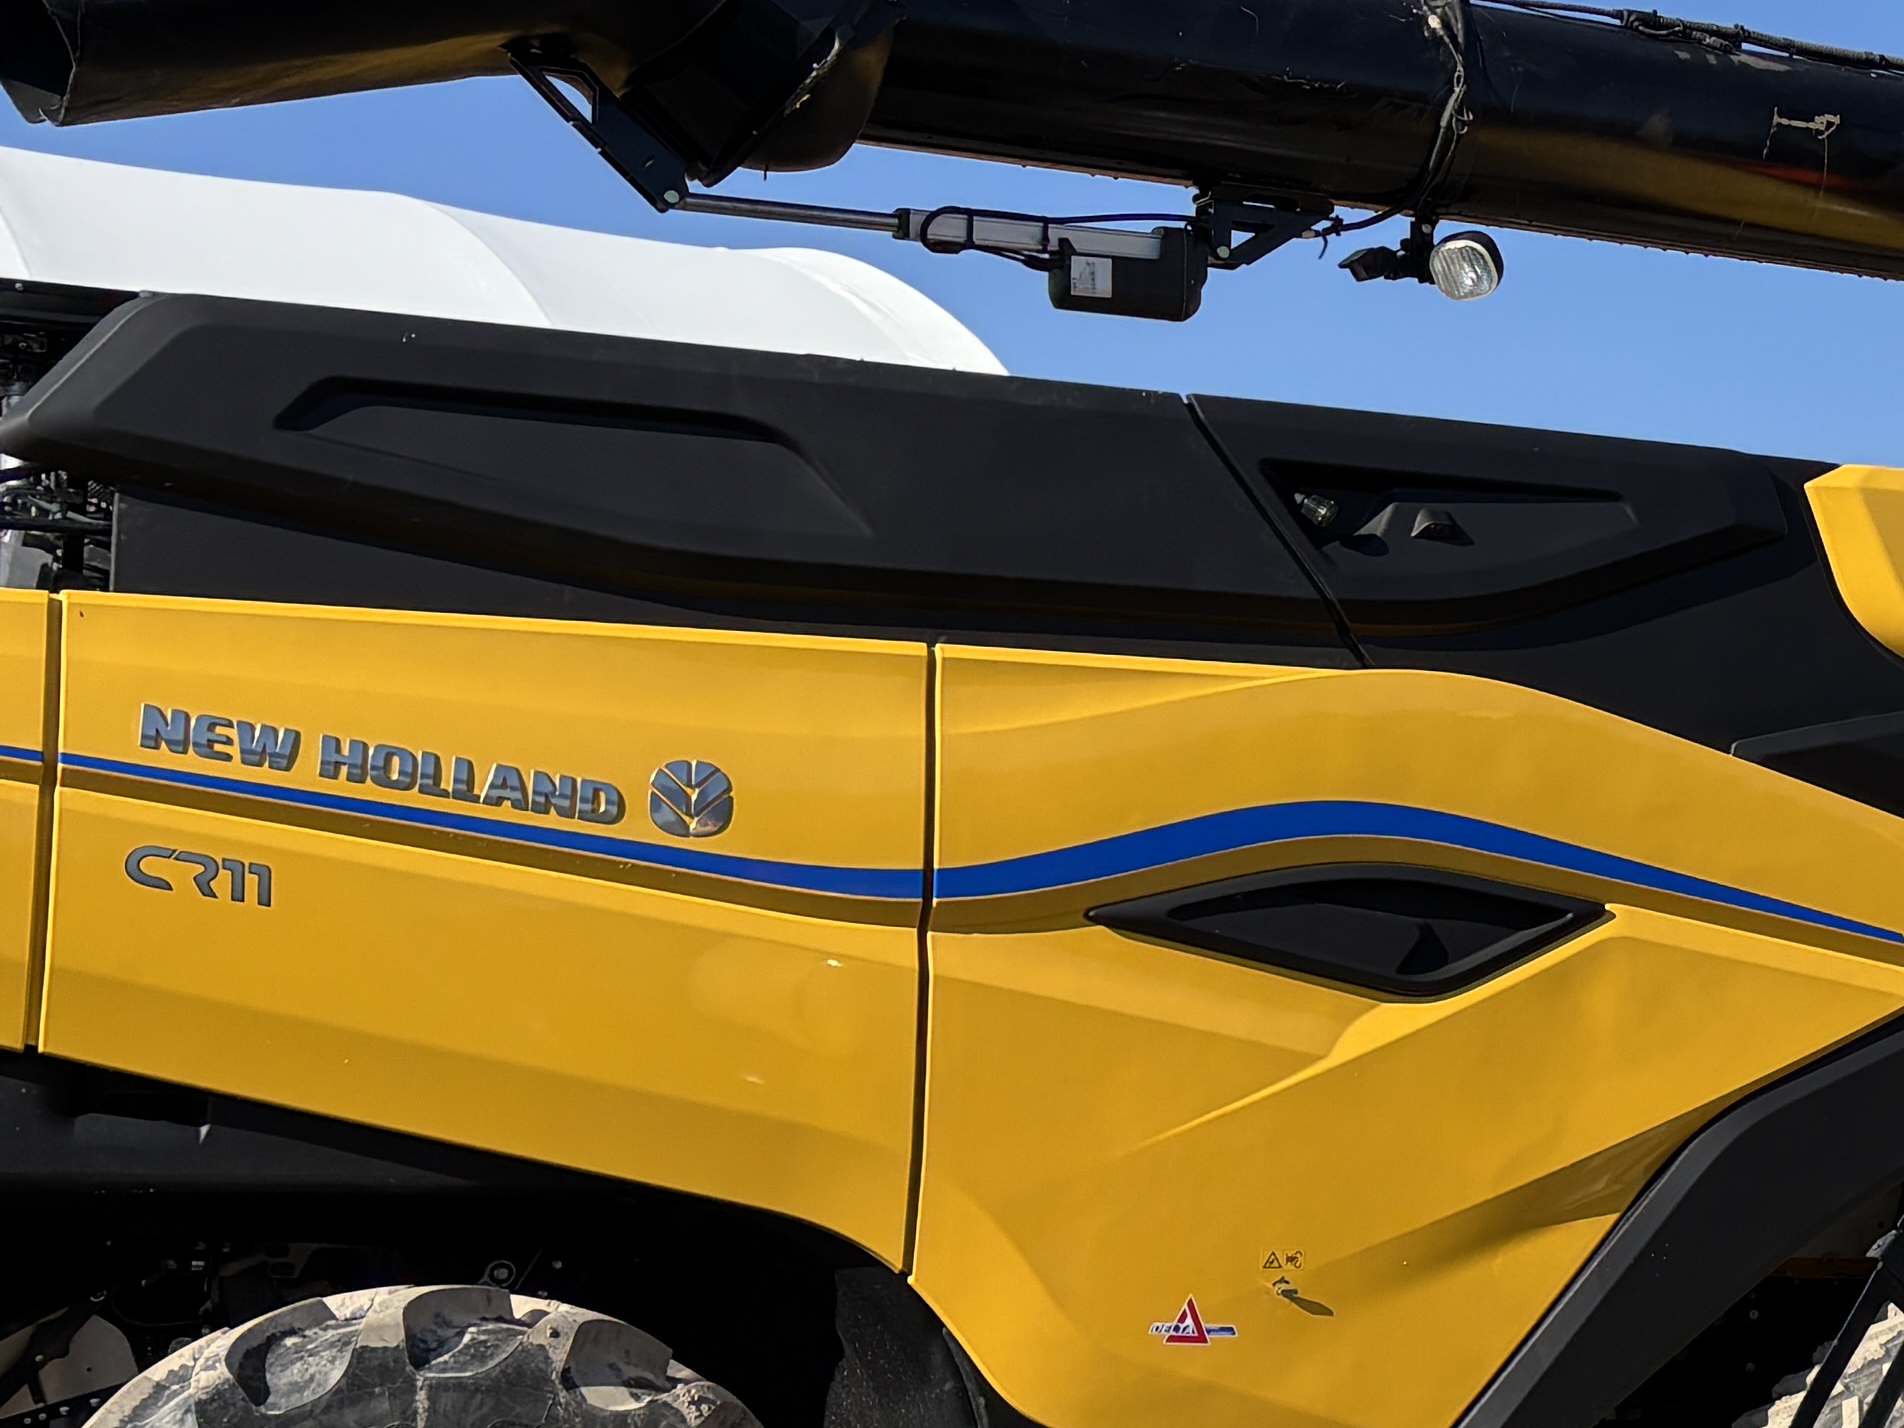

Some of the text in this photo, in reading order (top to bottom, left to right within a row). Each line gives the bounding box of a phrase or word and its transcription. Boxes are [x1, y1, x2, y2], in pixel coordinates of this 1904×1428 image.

[139, 703, 625, 825] NEW HOLLAND
[124, 845, 271, 907] CR11
